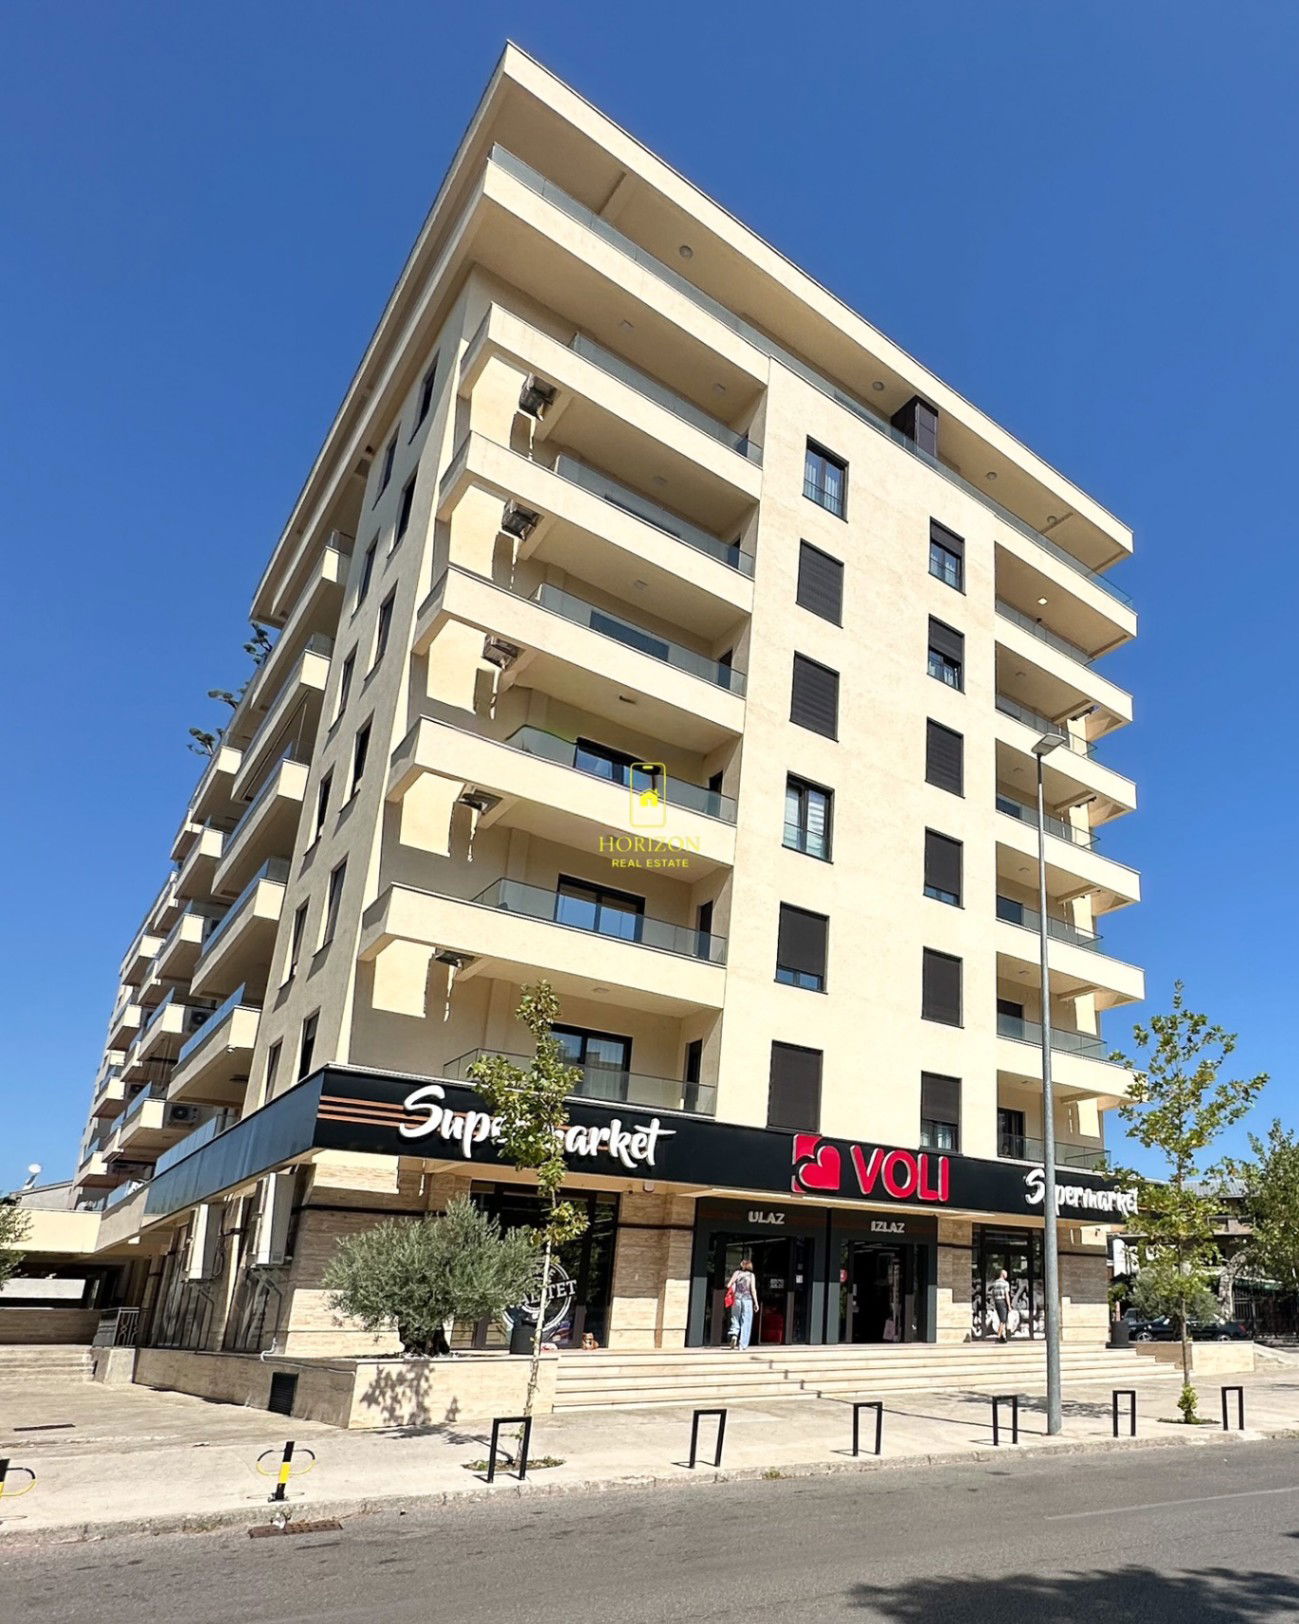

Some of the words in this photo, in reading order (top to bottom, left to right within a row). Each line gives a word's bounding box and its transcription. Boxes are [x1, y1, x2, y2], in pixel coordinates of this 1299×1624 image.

[399, 1085, 677, 1168] Supearket
[850, 1144, 950, 1202] VOLI
[1024, 1168, 1139, 1218] Spermarket
[748, 1211, 785, 1225] ULAZ
[870, 1220, 905, 1233] IZLAZ
